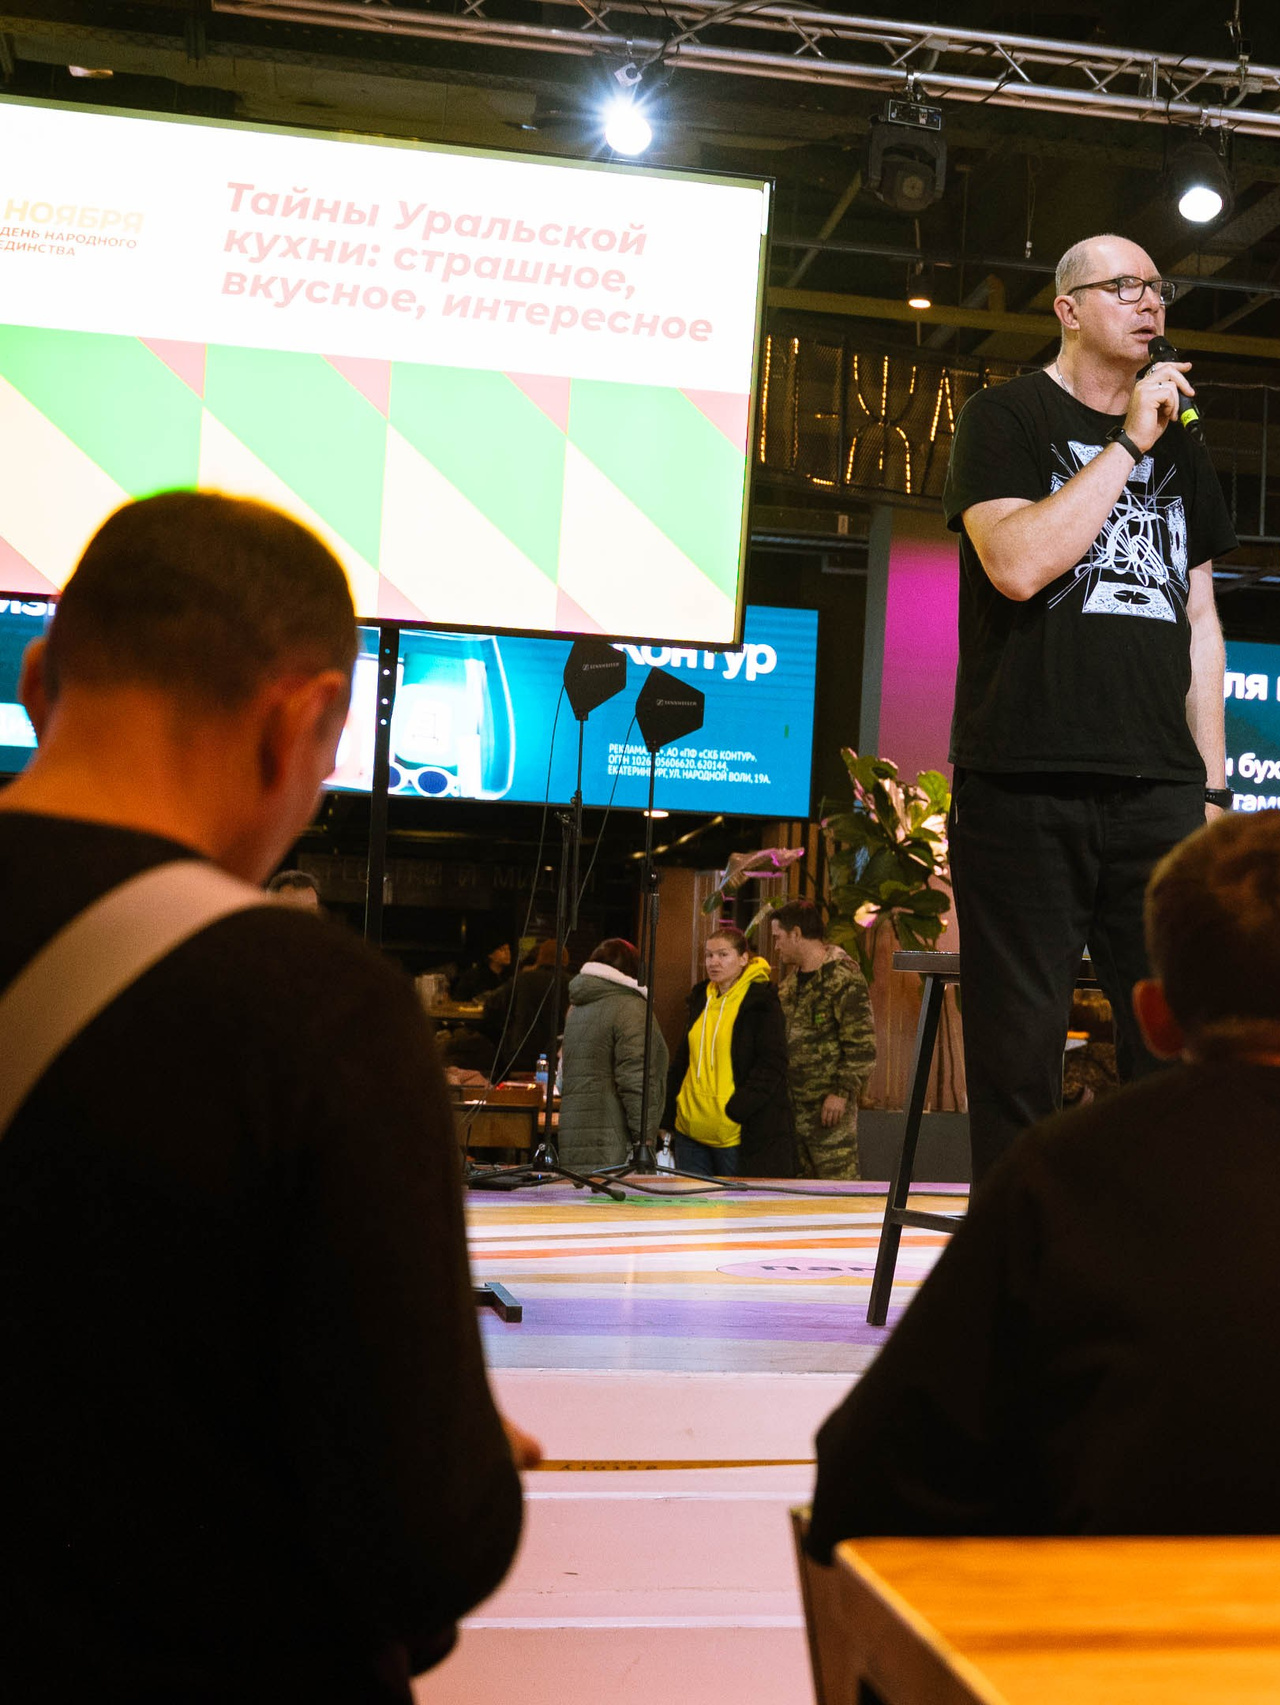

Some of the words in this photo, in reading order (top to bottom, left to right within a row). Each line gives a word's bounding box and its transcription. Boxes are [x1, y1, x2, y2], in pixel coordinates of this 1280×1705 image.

[0, 226, 40, 240] ДЕНЬ
[44, 230, 138, 250] НАРОДНОГО
[3, 197, 146, 235] НОЯБРЯ
[225, 181, 380, 228] Тайны
[393, 200, 648, 257] Уральской
[222, 227, 383, 268] кухни:
[392, 245, 637, 301] страшное,
[221, 270, 428, 321] вкусное,
[441, 291, 714, 344] интересное
[1223, 670, 1269, 702] ля
